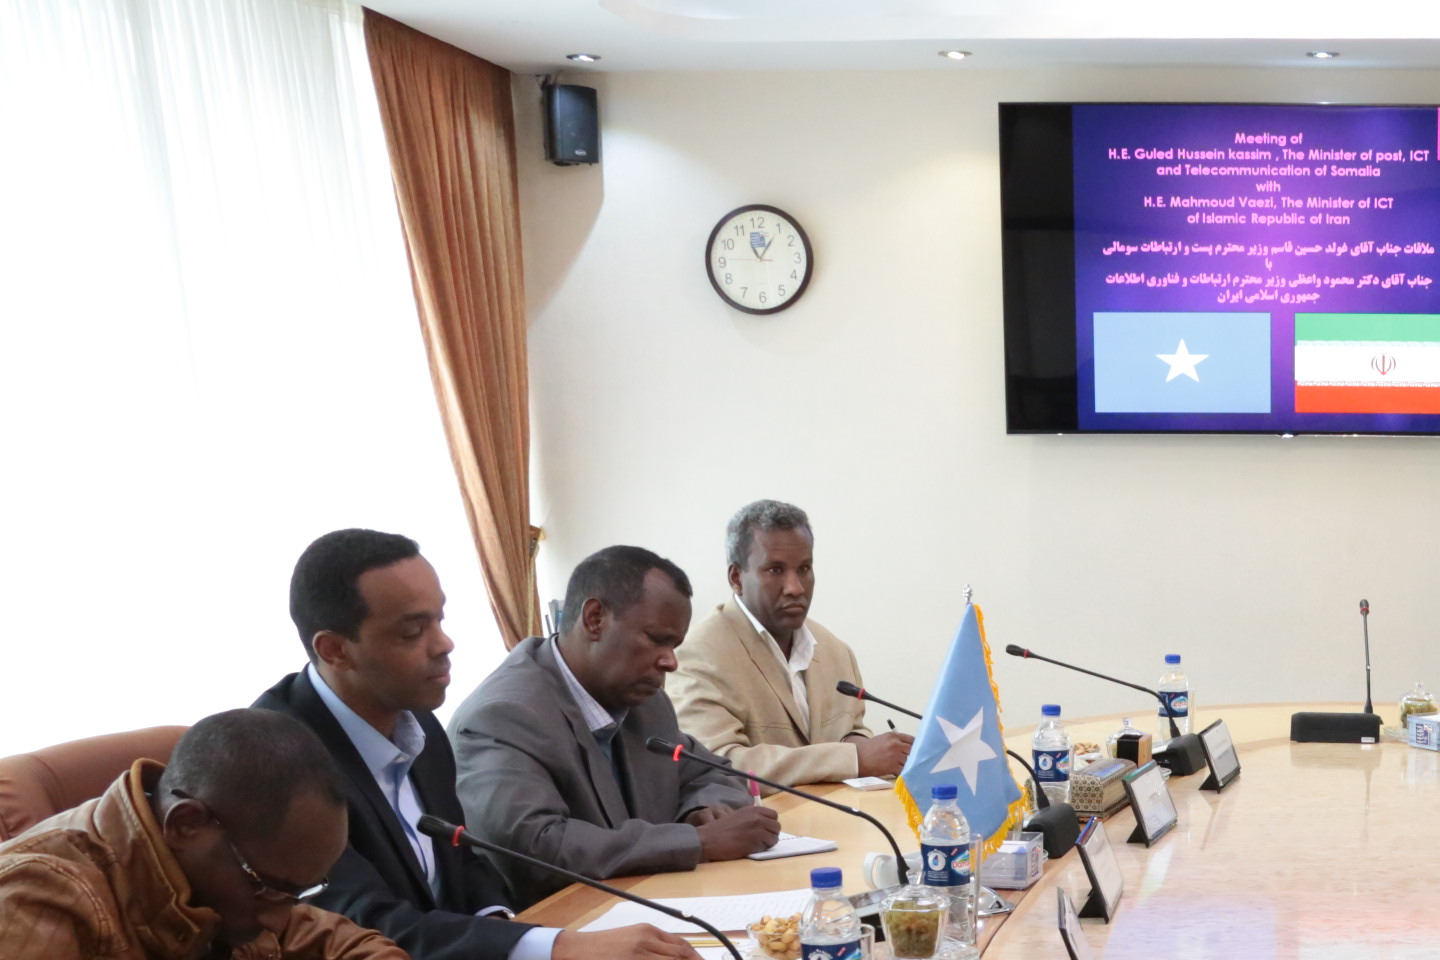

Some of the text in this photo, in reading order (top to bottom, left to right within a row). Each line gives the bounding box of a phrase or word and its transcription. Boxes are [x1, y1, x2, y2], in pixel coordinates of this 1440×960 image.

[1234, 132, 1303, 147] Meeting of
[1108, 148, 1131, 160] H.E.
[1134, 148, 1174, 161] Guled
[1177, 148, 1226, 161] Hussein
[1228, 148, 1272, 161] kassim
[1281, 149, 1305, 161] The
[1307, 149, 1357, 162] Minister
[1359, 149, 1373, 162] of
[1375, 149, 1406, 164] post,
[1409, 150, 1430, 162] ICT
[1156, 164, 1381, 177] and Telecommunication of Somalia
[1255, 180, 1282, 192] with
[1143, 196, 1394, 210] H.E. Mahmoud Vaezi, The Minister of ICT
[750, 217, 766, 229] 12
[1186, 212, 1351, 227] of Islamic Republic of Iran
[734, 224, 745, 236] 11
[776, 223, 782, 234] 1
[721, 238, 735, 250] 10
[787, 235, 795, 247] 2
[1102, 240, 1139, 256] سومالی
[1140, 240, 1182, 256] ارتباطات
[1270, 241, 1294, 255] قاسم
[1403, 241, 1435, 255] ملاقات
[1191, 242, 1213, 257] پست
[1214, 242, 1245, 256] محترم
[1246, 243, 1269, 256] وزیر
[1294, 244, 1323, 257] حسین
[1349, 241, 1375, 257] آقای
[1375, 242, 1402, 258] جناب
[718, 256, 726, 269] 9
[793, 252, 802, 264] 3
[1264, 257, 1273, 272] با
[725, 273, 733, 285] 8
[790, 270, 797, 281] 4
[1105, 272, 1145, 285] اطلاعات
[1146, 272, 1180, 288] فناوری
[1189, 273, 1231, 288] ارتباطات
[1232, 274, 1263, 288] محترم
[1264, 275, 1287, 288] وزیر
[1288, 273, 1322, 288] واعظی
[1323, 275, 1355, 288] محمود
[1356, 274, 1380, 288] دکتر
[1380, 273, 1406, 289] آقای
[1406, 275, 1433, 289] جناب
[740, 286, 748, 299] 7
[759, 291, 767, 304] 6
[778, 285, 786, 297] 5
[1217, 289, 1321, 305] جمهوری اسلامی ایران
